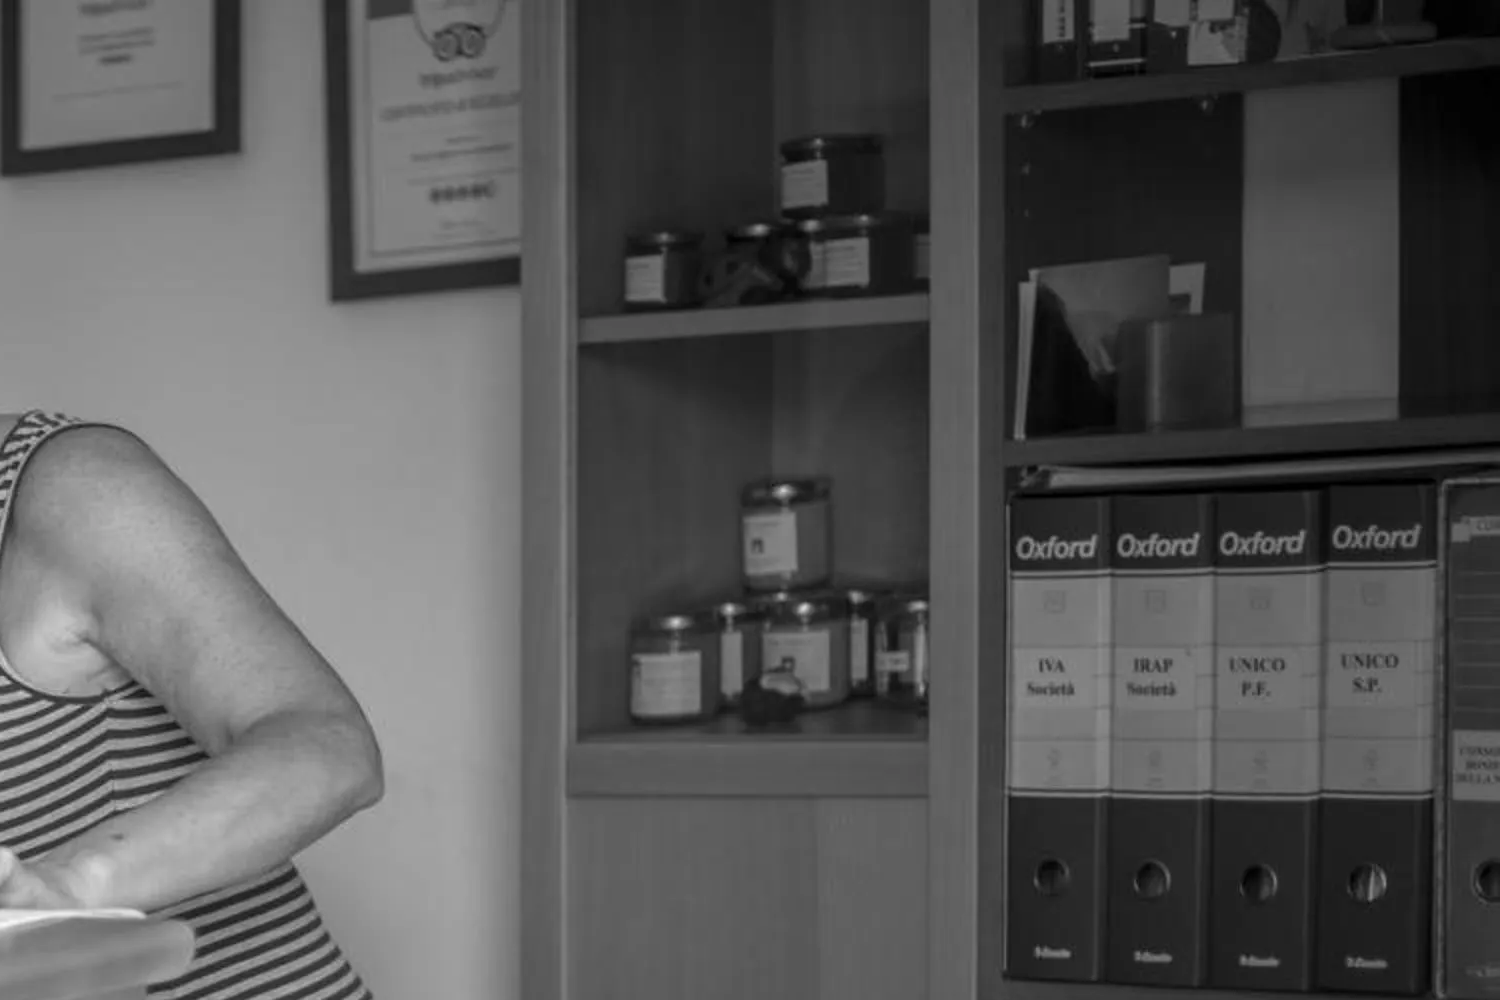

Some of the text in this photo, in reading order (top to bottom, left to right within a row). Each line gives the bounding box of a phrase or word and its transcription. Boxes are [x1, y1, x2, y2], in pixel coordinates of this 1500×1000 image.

[1116, 531, 1201, 558] Oxford
[1218, 529, 1307, 556] Oxford
[1332, 523, 1422, 550] Oxford
[1015, 534, 1098, 560] Oxford
[1038, 658, 1065, 673] IVA
[1133, 658, 1173, 673] IRAP
[1228, 657, 1286, 673] UNICO
[1340, 654, 1399, 669] UNICO
[1027, 681, 1075, 697] Società
[1126, 681, 1177, 697] Società
[1241, 681, 1271, 697] P.F.
[1352, 677, 1382, 693] S.P.
